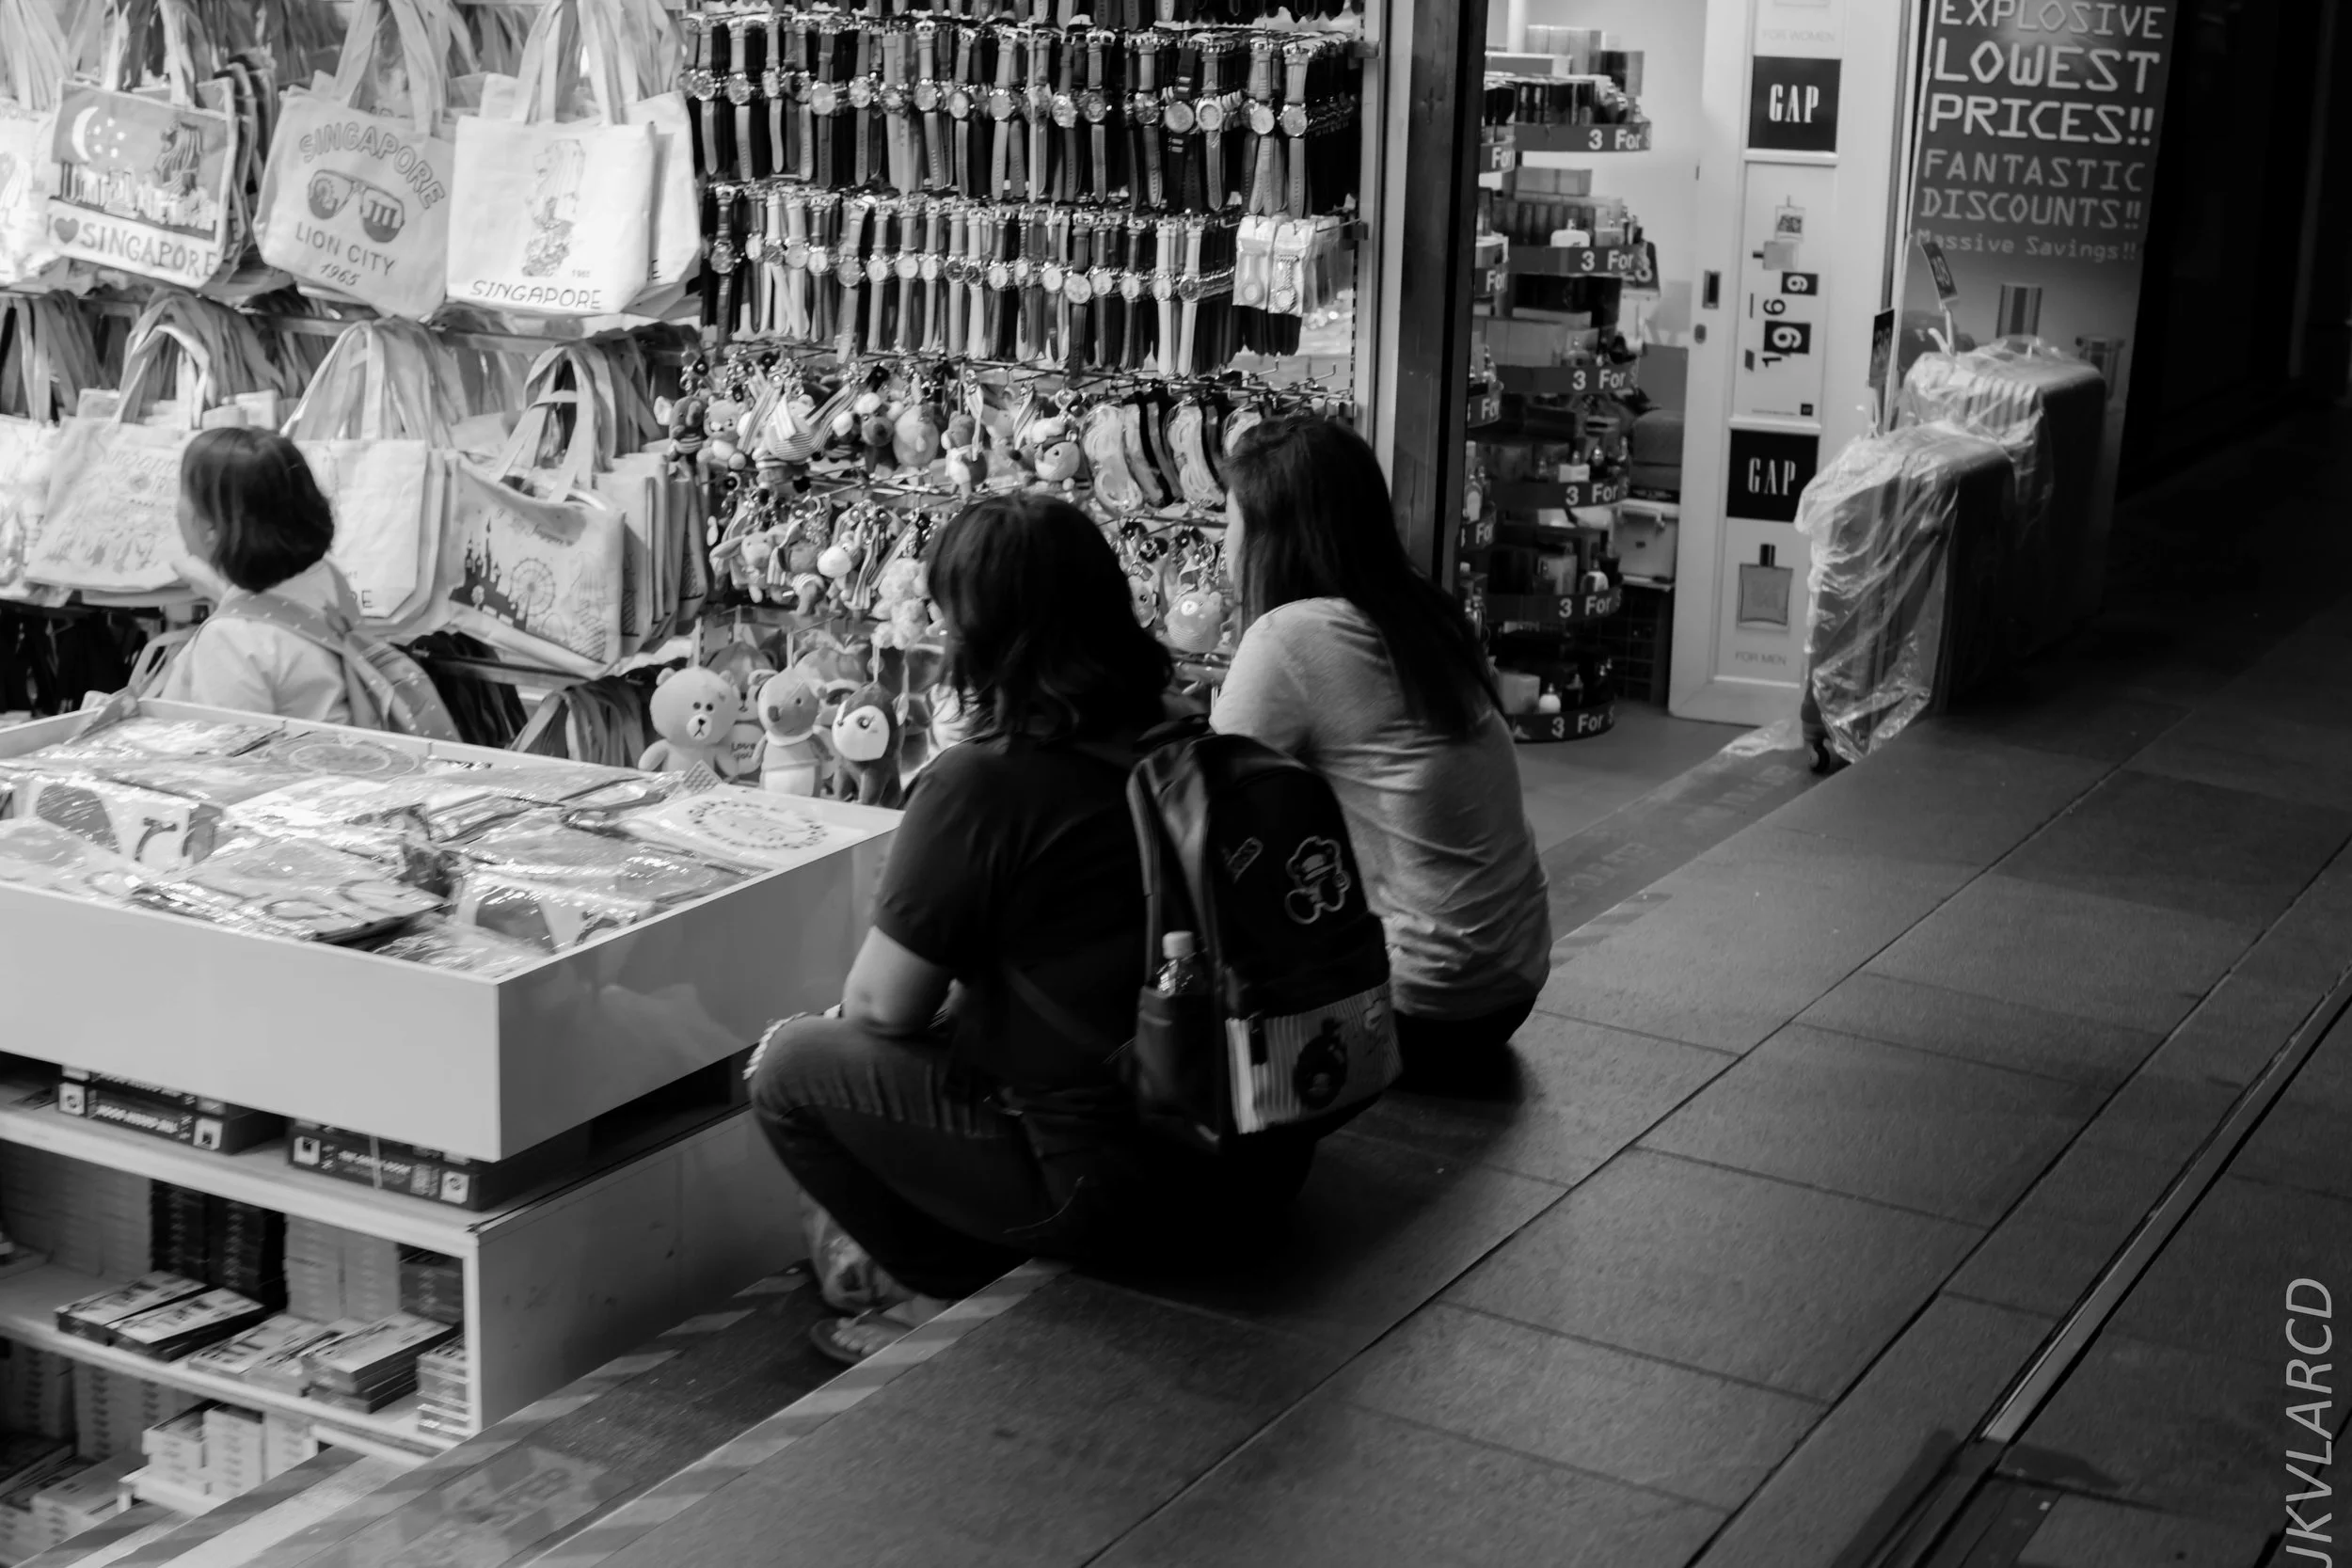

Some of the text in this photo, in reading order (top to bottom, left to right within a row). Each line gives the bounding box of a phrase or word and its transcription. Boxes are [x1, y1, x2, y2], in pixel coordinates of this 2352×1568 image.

[1939, 0, 2166, 39] EXPLOSIVE
[1934, 38, 2160, 94] LOWEST
[1769, 83, 1820, 123] GAP
[1929, 93, 2154, 146] PRICES!!
[1588, 129, 1603, 150] 3
[1614, 129, 1642, 150] For
[299, 121, 446, 210] SINGAPORE
[1923, 149, 2146, 192] FANTASTIC
[1920, 187, 2142, 229] DISCOUNTS!!
[80, 221, 218, 278] SINGAPORE
[295, 222, 395, 276] LION CITY
[1581, 250, 1595, 271] 3
[1607, 249, 1633, 271] For
[2026, 235, 2137, 263] Savings!!
[320, 262, 361, 287] 1965
[470, 280, 602, 310] SINGAPORE
[1572, 370, 1586, 391] 3
[1598, 369, 1626, 389] For
[1565, 485, 1580, 506] 3
[1592, 483, 1618, 503] For
[1747, 457, 1796, 496] GAP
[1559, 597, 1572, 618] 3
[1585, 595, 1612, 615] For
[1551, 717, 1565, 738] 3
[1578, 714, 1604, 734] For
